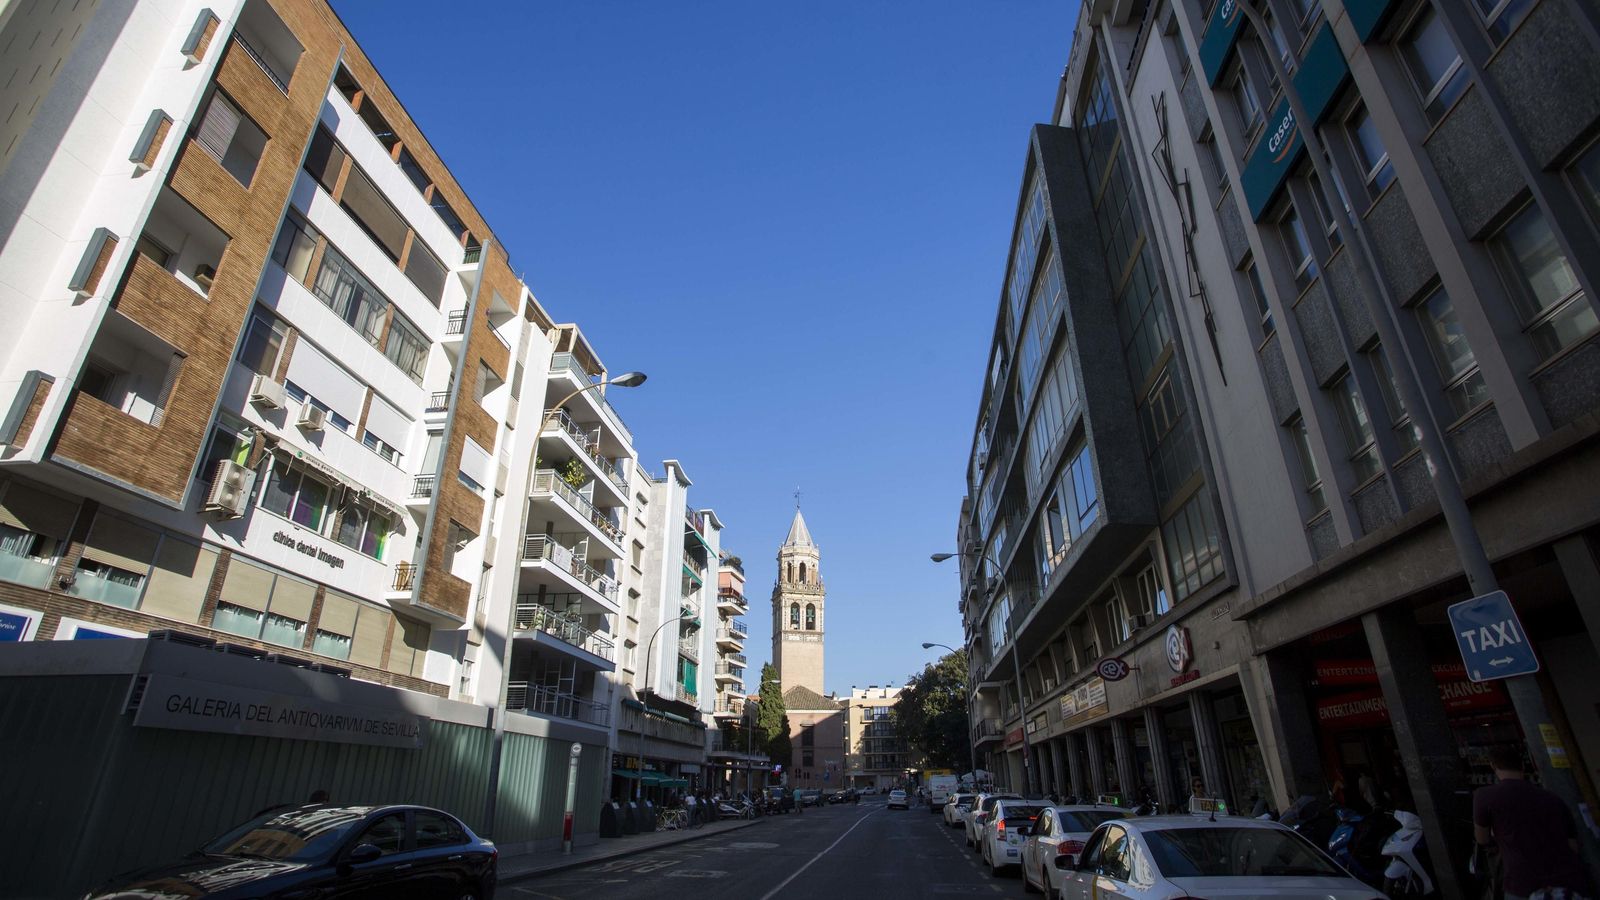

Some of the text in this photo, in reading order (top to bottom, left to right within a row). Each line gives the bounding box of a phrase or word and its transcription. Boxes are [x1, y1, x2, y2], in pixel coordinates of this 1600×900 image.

[1460, 619, 1522, 654] TAXI
[1317, 666, 1376, 677] ENTERTAIN
[166, 694, 420, 737] GALERIA DEL ANTIQVARIVM DE SEVILLA
[1319, 697, 1386, 720] ENTERTAINMEN
